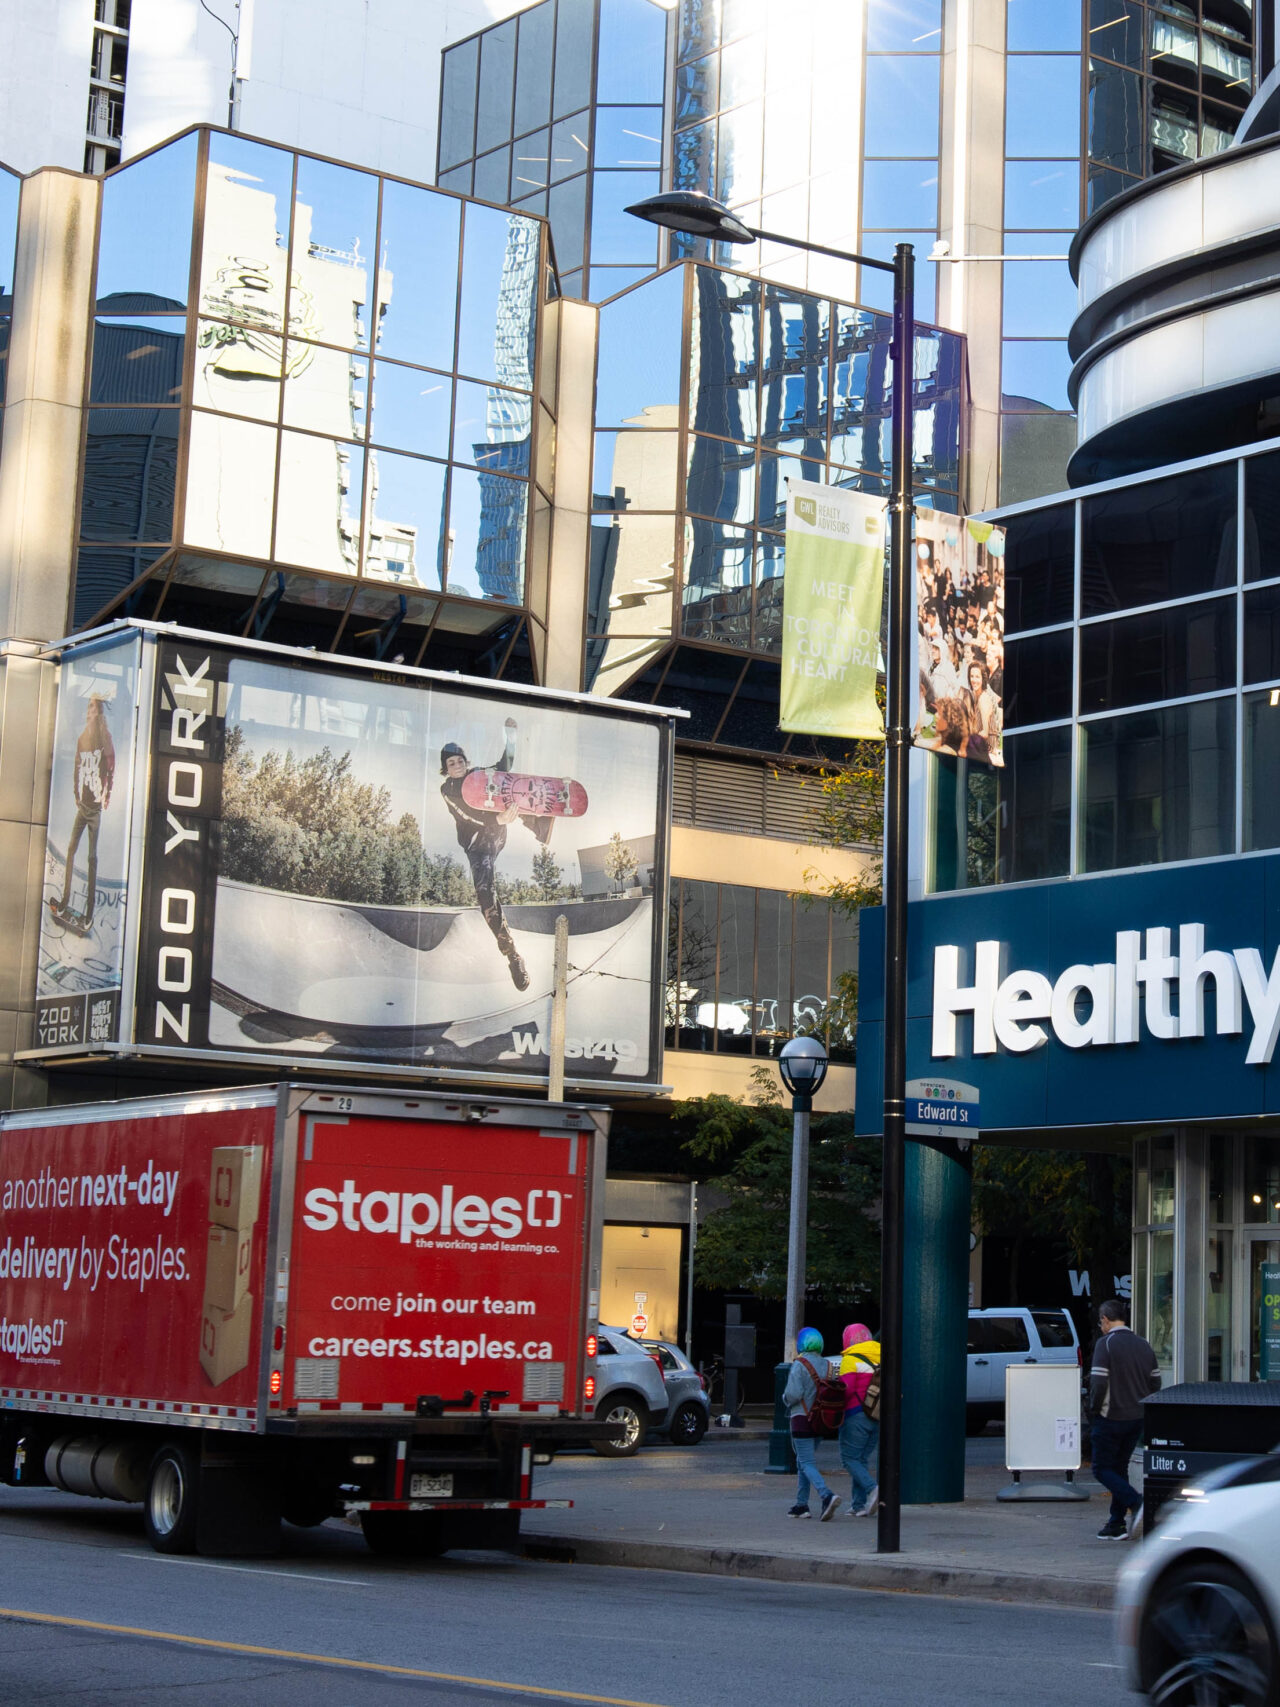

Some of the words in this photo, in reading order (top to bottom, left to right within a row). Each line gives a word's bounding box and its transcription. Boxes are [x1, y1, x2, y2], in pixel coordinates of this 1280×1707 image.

[800, 500, 815, 515] GWL
[818, 504, 841, 520] REALTY
[817, 517, 850, 534] ADVISORS
[811, 578, 855, 600] MEET
[838, 604, 855, 621] IN
[786, 614, 880, 649] TORONTO'S
[797, 638, 879, 668] CULTURAL
[790, 656, 847, 682] HEART
[165, 653, 211, 855] YORK
[155, 887, 196, 1043] ZOO
[39, 1006, 70, 1026] ZOO
[38, 1024, 79, 1045] YORK
[339, 1097, 353, 1110] 29
[918, 1102, 957, 1121] Edward
[960, 1108, 968, 1122] St
[3, 1166, 78, 1209] another
[80, 1159, 179, 1217] next-day
[303, 1180, 523, 1244] staples
[415, 1238, 433, 1248] the
[436, 1239, 478, 1252] working
[479, 1241, 499, 1250] and
[501, 1241, 543, 1255] learning
[544, 1245, 560, 1253] co.
[0, 1236, 77, 1291] delivery
[79, 1235, 104, 1291] by
[106, 1234, 190, 1292] Staples.
[331, 1295, 391, 1312] come
[394, 1292, 436, 1317] join
[441, 1298, 477, 1314] our
[483, 1296, 536, 1315] team
[308, 1334, 552, 1365] careers.staples.ca
[1151, 1455, 1173, 1470] Litter
